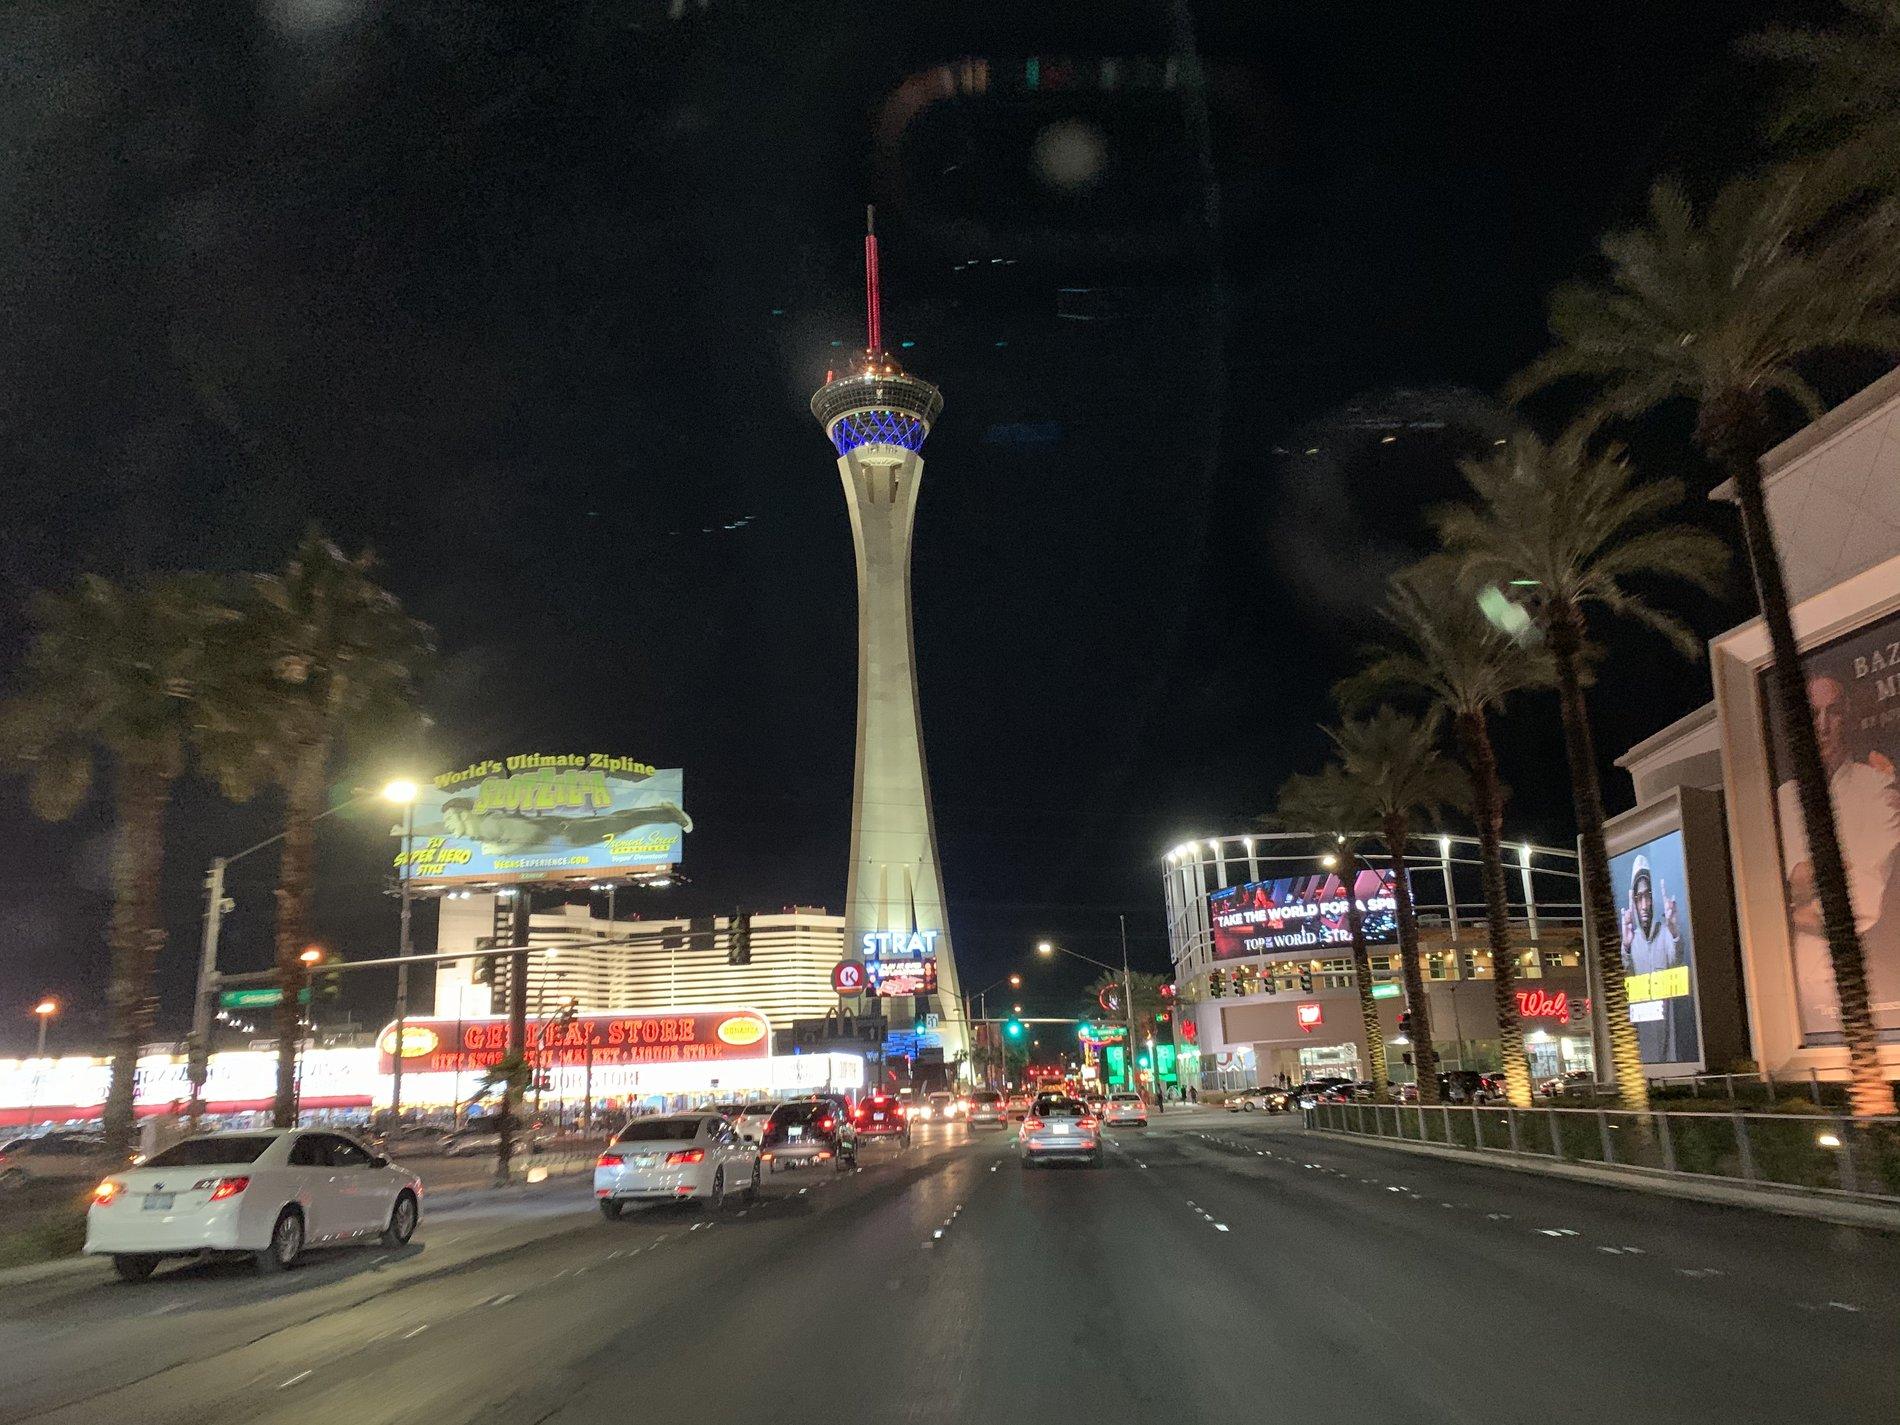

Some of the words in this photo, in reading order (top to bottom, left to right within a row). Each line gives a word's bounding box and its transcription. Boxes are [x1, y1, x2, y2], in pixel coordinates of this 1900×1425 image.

[434, 760, 503, 788] World's
[506, 752, 586, 770] Ultimate
[589, 753, 656, 776] Zipline
[437, 847, 472, 865] HERO
[1217, 912, 1243, 928] TAKE
[1243, 908, 1268, 924] THE
[1267, 903, 1318, 920] WORLD
[1320, 900, 1349, 915] FOR
[863, 930, 937, 955] STRAT
[1244, 938, 1265, 950] TOP
[1273, 930, 1317, 948] WORLD
[608, 1018, 695, 1045] STORE
[631, 1044, 679, 1062] LIQUOR
